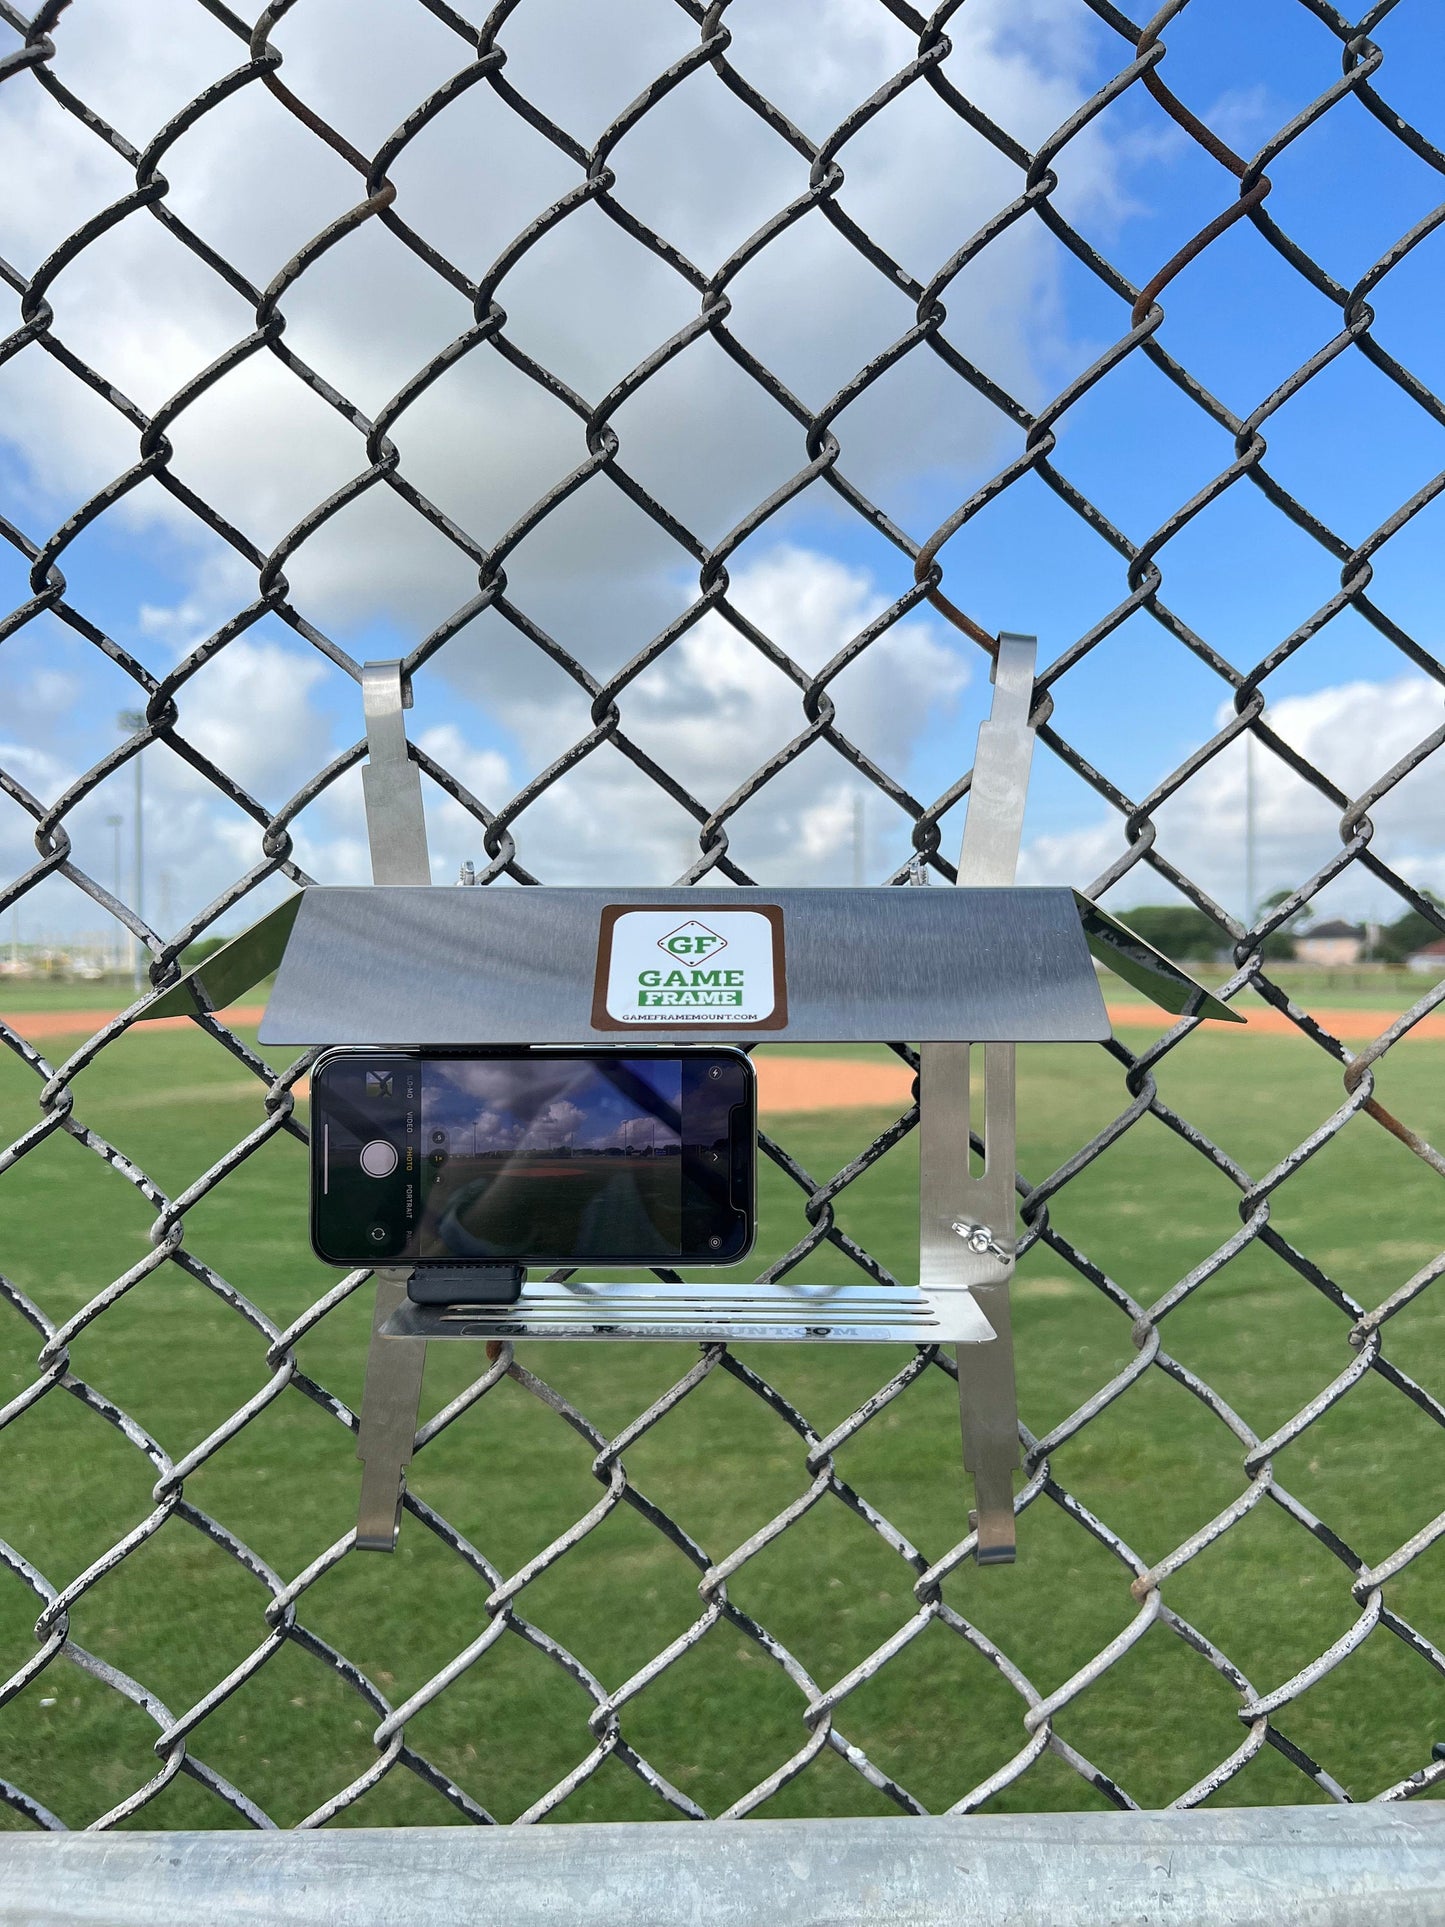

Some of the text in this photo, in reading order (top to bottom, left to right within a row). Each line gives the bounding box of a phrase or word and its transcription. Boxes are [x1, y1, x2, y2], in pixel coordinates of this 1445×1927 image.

[667, 936, 717, 954] GF
[638, 970, 744, 987] GAME
[645, 991, 737, 1006] FRAME
[406, 1111, 414, 1133] VIDEO
[405, 1184, 413, 1219] PORTRAIT
